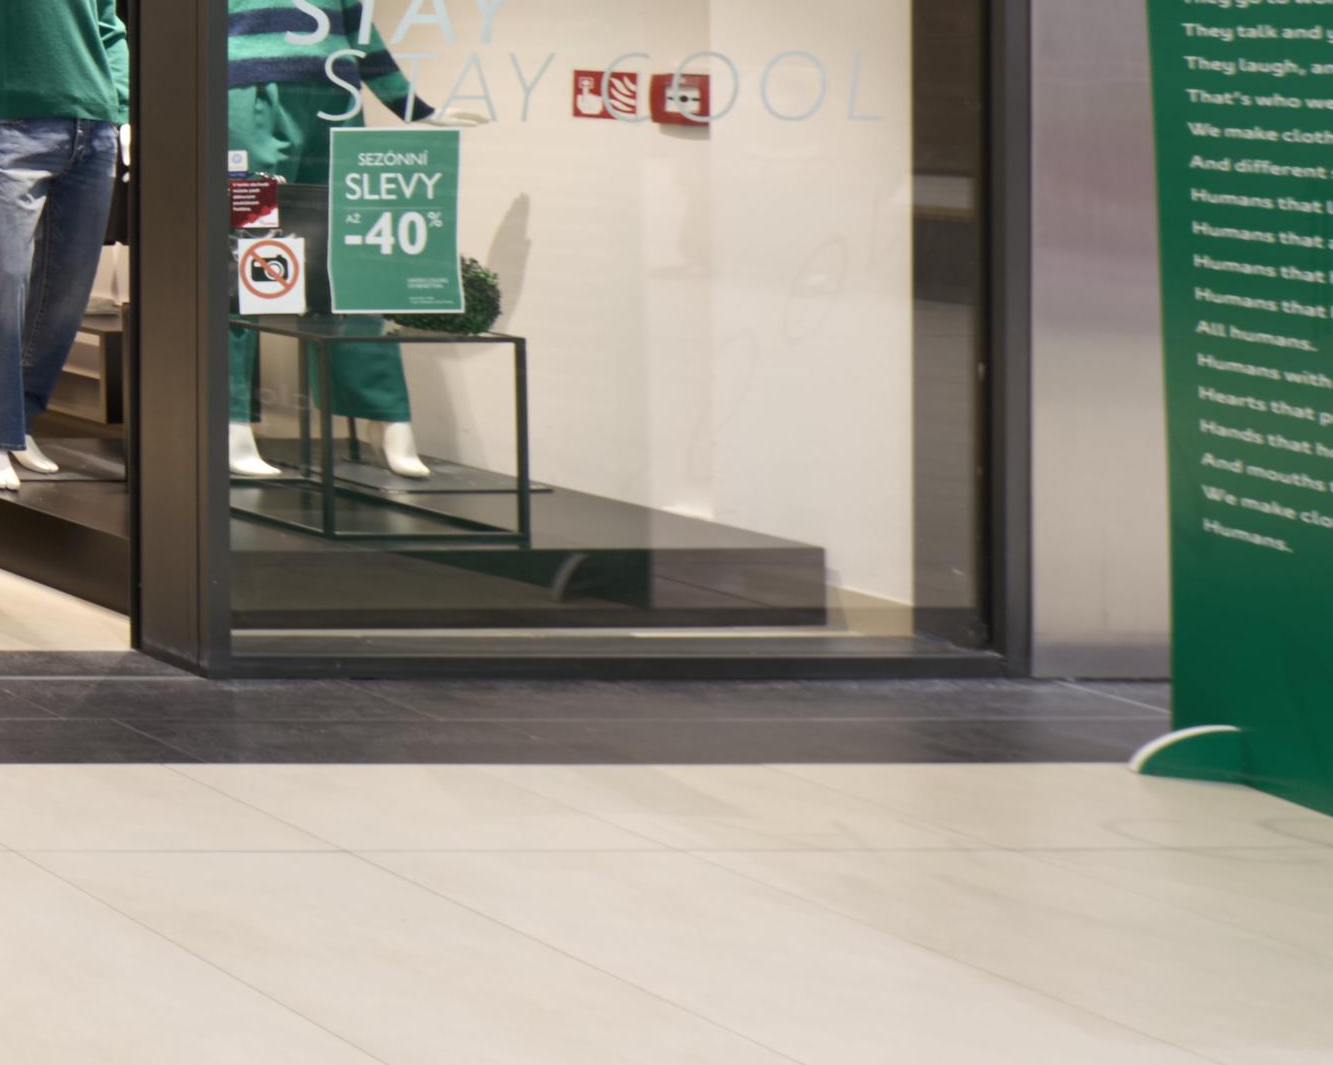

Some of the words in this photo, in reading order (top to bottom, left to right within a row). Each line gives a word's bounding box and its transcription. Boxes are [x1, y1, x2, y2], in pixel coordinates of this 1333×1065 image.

[1181, 23, 1234, 42] They
[1237, 24, 1279, 38] talk
[1282, 24, 1323, 39] and
[1183, 56, 1237, 75] They
[1238, 57, 1307, 77] laugh,
[315, 49, 556, 124] STAY
[601, 49, 885, 124] COOL
[1185, 89, 1253, 106] That's
[1255, 93, 1302, 108] who
[1187, 121, 1221, 137] We
[1224, 126, 1279, 141] make
[358, 150, 428, 166] SEZÓNNÍ
[1189, 155, 1231, 171] And
[1234, 159, 1328, 179] different
[345, 172, 442, 200] SLEVY
[1190, 187, 1275, 209] Humans
[1277, 197, 1324, 214] that
[1192, 221, 1276, 243] Humans
[1279, 231, 1326, 249] that
[1193, 253, 1277, 277] Humans
[1280, 266, 1326, 284] that
[1194, 286, 1279, 311] Humans
[1281, 300, 1328, 319] that
[1195, 320, 1227, 337] All
[1229, 325, 1319, 352] humans.
[1197, 352, 1281, 380] Humans
[1284, 371, 1333, 389] with
[1198, 386, 1268, 412] Hearts
[1270, 400, 1316, 421] that
[1199, 419, 1264, 445] Hands
[1266, 434, 1313, 455] that
[1200, 452, 1243, 473] And
[1245, 465, 1327, 492] mouths
[1200, 484, 1238, 506] We
[1240, 497, 1298, 520] make
[1202, 517, 1294, 554] Humans.
